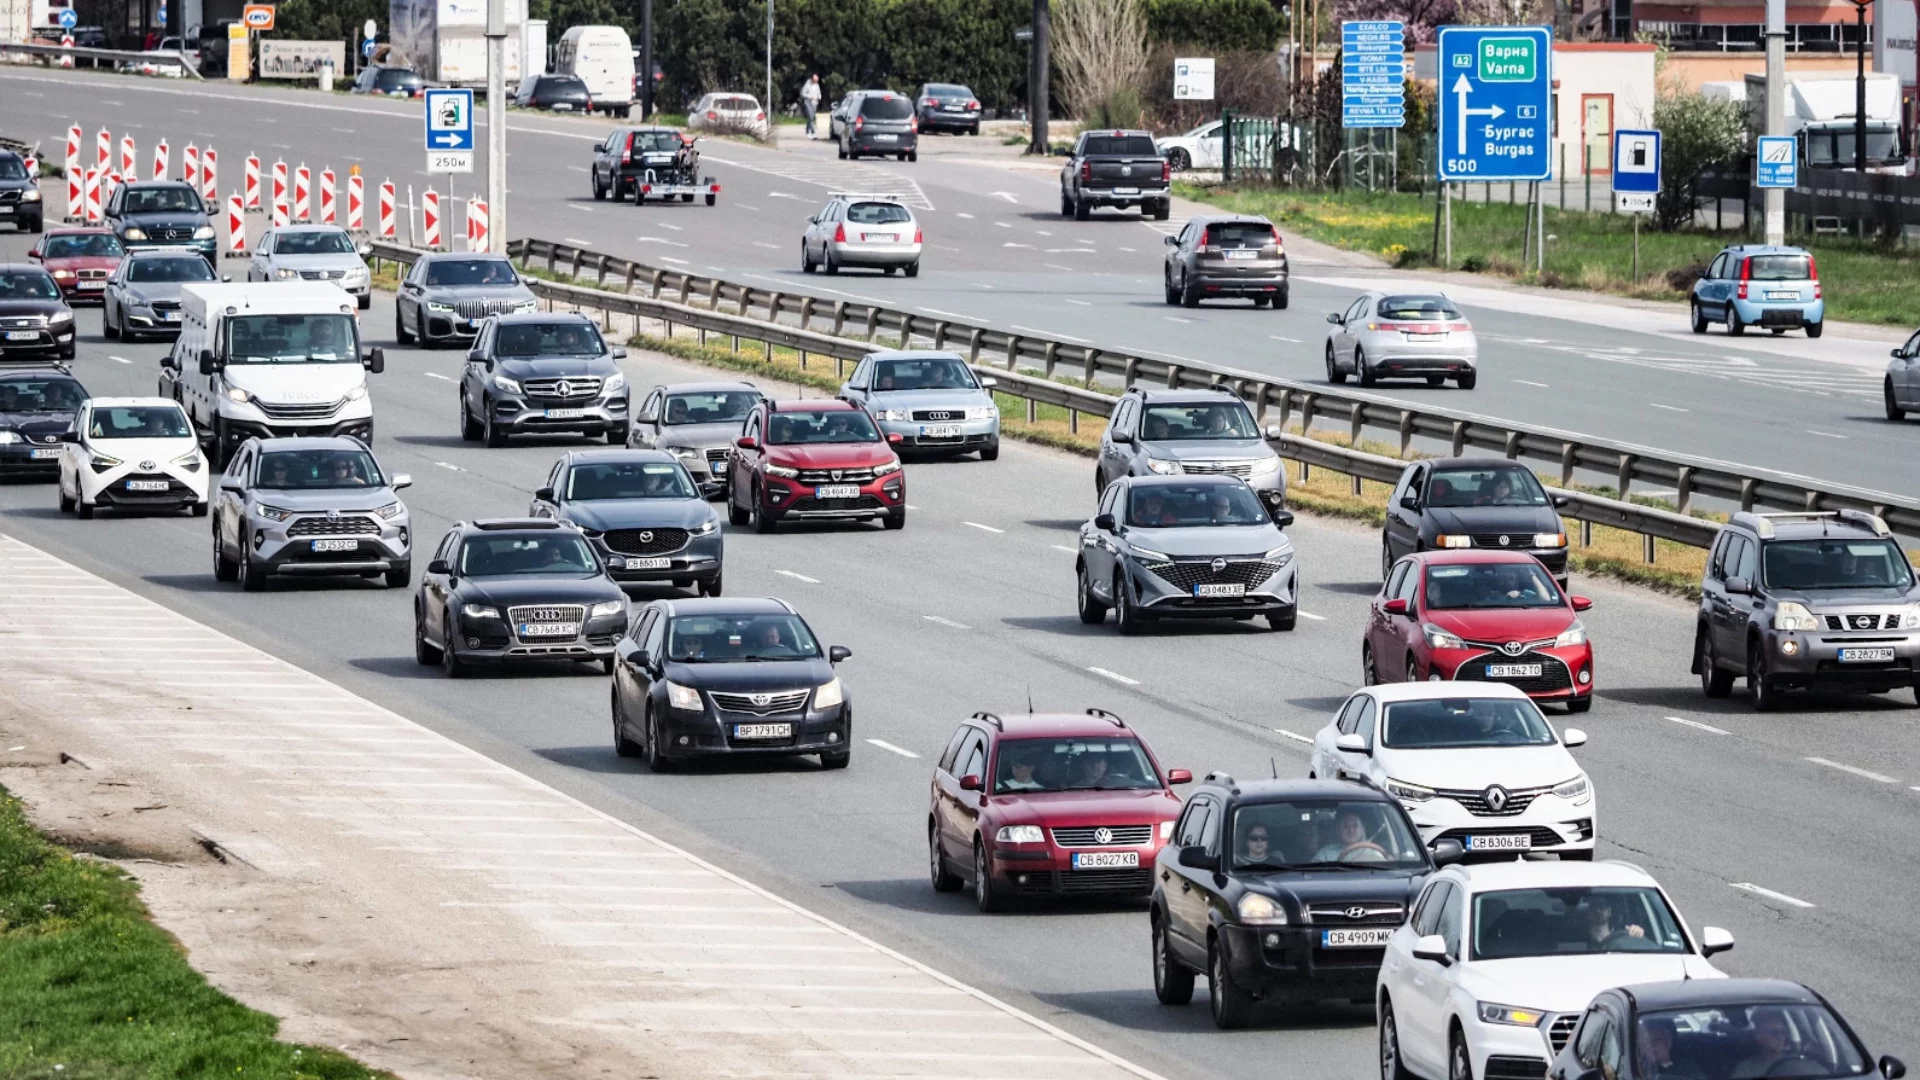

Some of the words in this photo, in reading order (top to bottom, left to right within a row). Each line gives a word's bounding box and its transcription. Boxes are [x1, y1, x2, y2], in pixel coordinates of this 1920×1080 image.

[1358, 23, 1389, 31] EXALCO
[1485, 44, 1529, 59] Варна
[1456, 56, 1469, 65] A2
[1486, 61, 1526, 75] Varna
[1523, 107, 1530, 116] 6
[1485, 124, 1535, 141] Бургас
[1485, 142, 1534, 159] Burgas
[1447, 158, 1477, 173] 500
[282, 391, 320, 400] IVECO
[628, 560, 638, 569] CB
[1200, 586, 1210, 594] CB
[527, 626, 539, 634] CB
[1844, 650, 1856, 660] CB
[1857, 650, 1879, 660] 2827
[1492, 666, 1504, 676] CB
[1506, 665, 1526, 675] 1862
[740, 726, 752, 736] BP
[754, 726, 775, 736] 1791
[776, 725, 790, 735] CH
[1472, 837, 1486, 848] CB
[1514, 836, 1529, 847] BE
[1080, 855, 1094, 866] CB
[1095, 854, 1121, 866] 8027
[1122, 853, 1137, 865] KB
[1330, 933, 1345, 943] CB
[1348, 932, 1375, 943] 4909
[1377, 931, 1391, 942] MK
